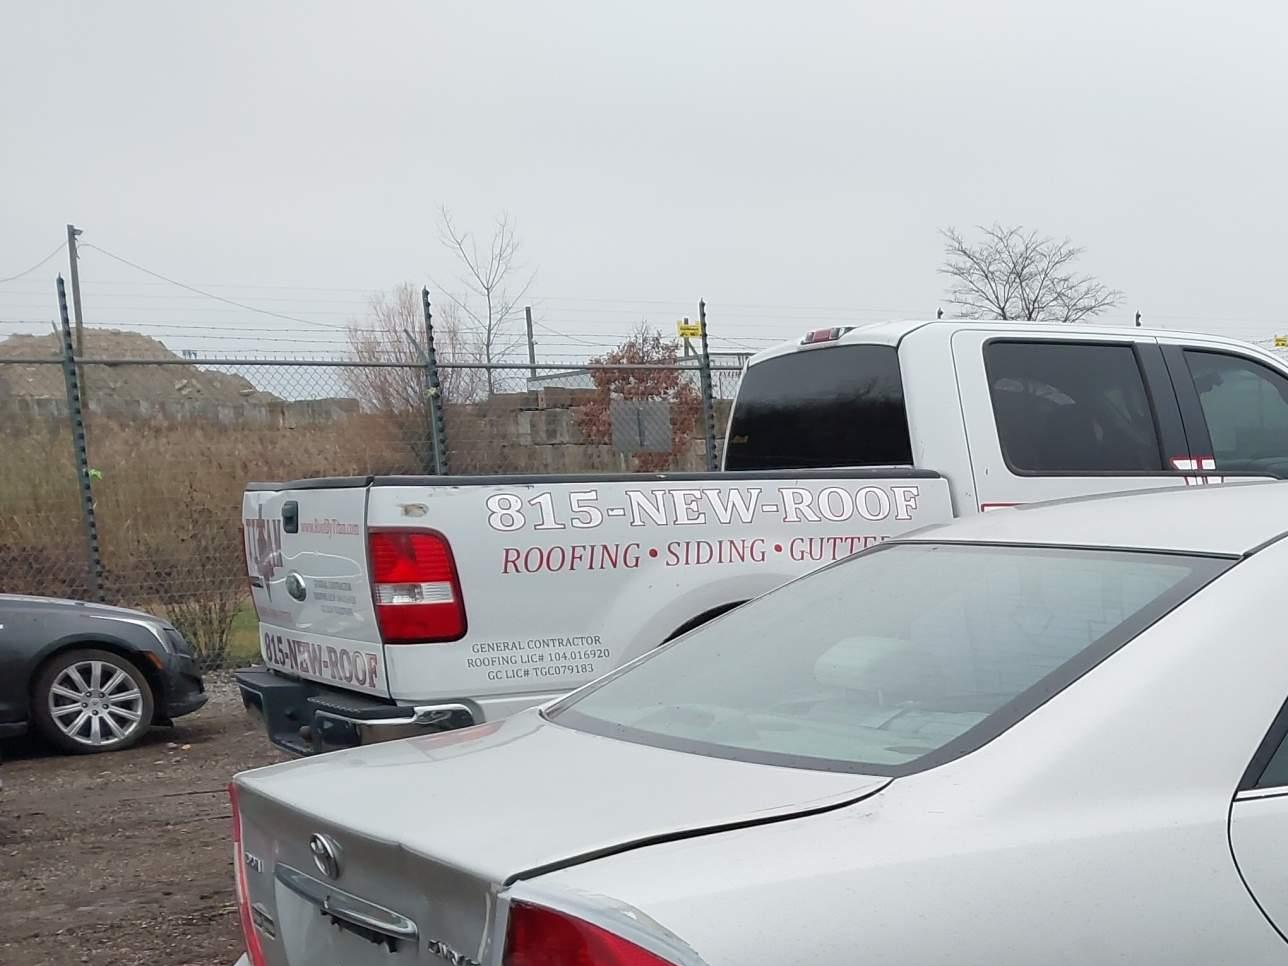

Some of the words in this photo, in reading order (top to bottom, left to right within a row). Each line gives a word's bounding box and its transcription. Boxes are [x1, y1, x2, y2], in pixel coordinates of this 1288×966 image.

[486, 485, 920, 532] 815-NEW-ROOF
[502, 543, 641, 574] ROOFING
[665, 538, 766, 567] SIDING
[789, 535, 892, 561] GUTT
[467, 654, 517, 668] ROOFING
[520, 652, 544, 664] LIC#
[548, 648, 610, 662] 104.016920
[472, 641, 525, 654] GENERAL
[527, 635, 602, 649] CONTRACTOR
[264, 632, 378, 688] 815-NEW-ROOF
[487, 670, 503, 681] GC
[505, 668, 530, 679] LIC#
[532, 663, 595, 678] TGC079183
